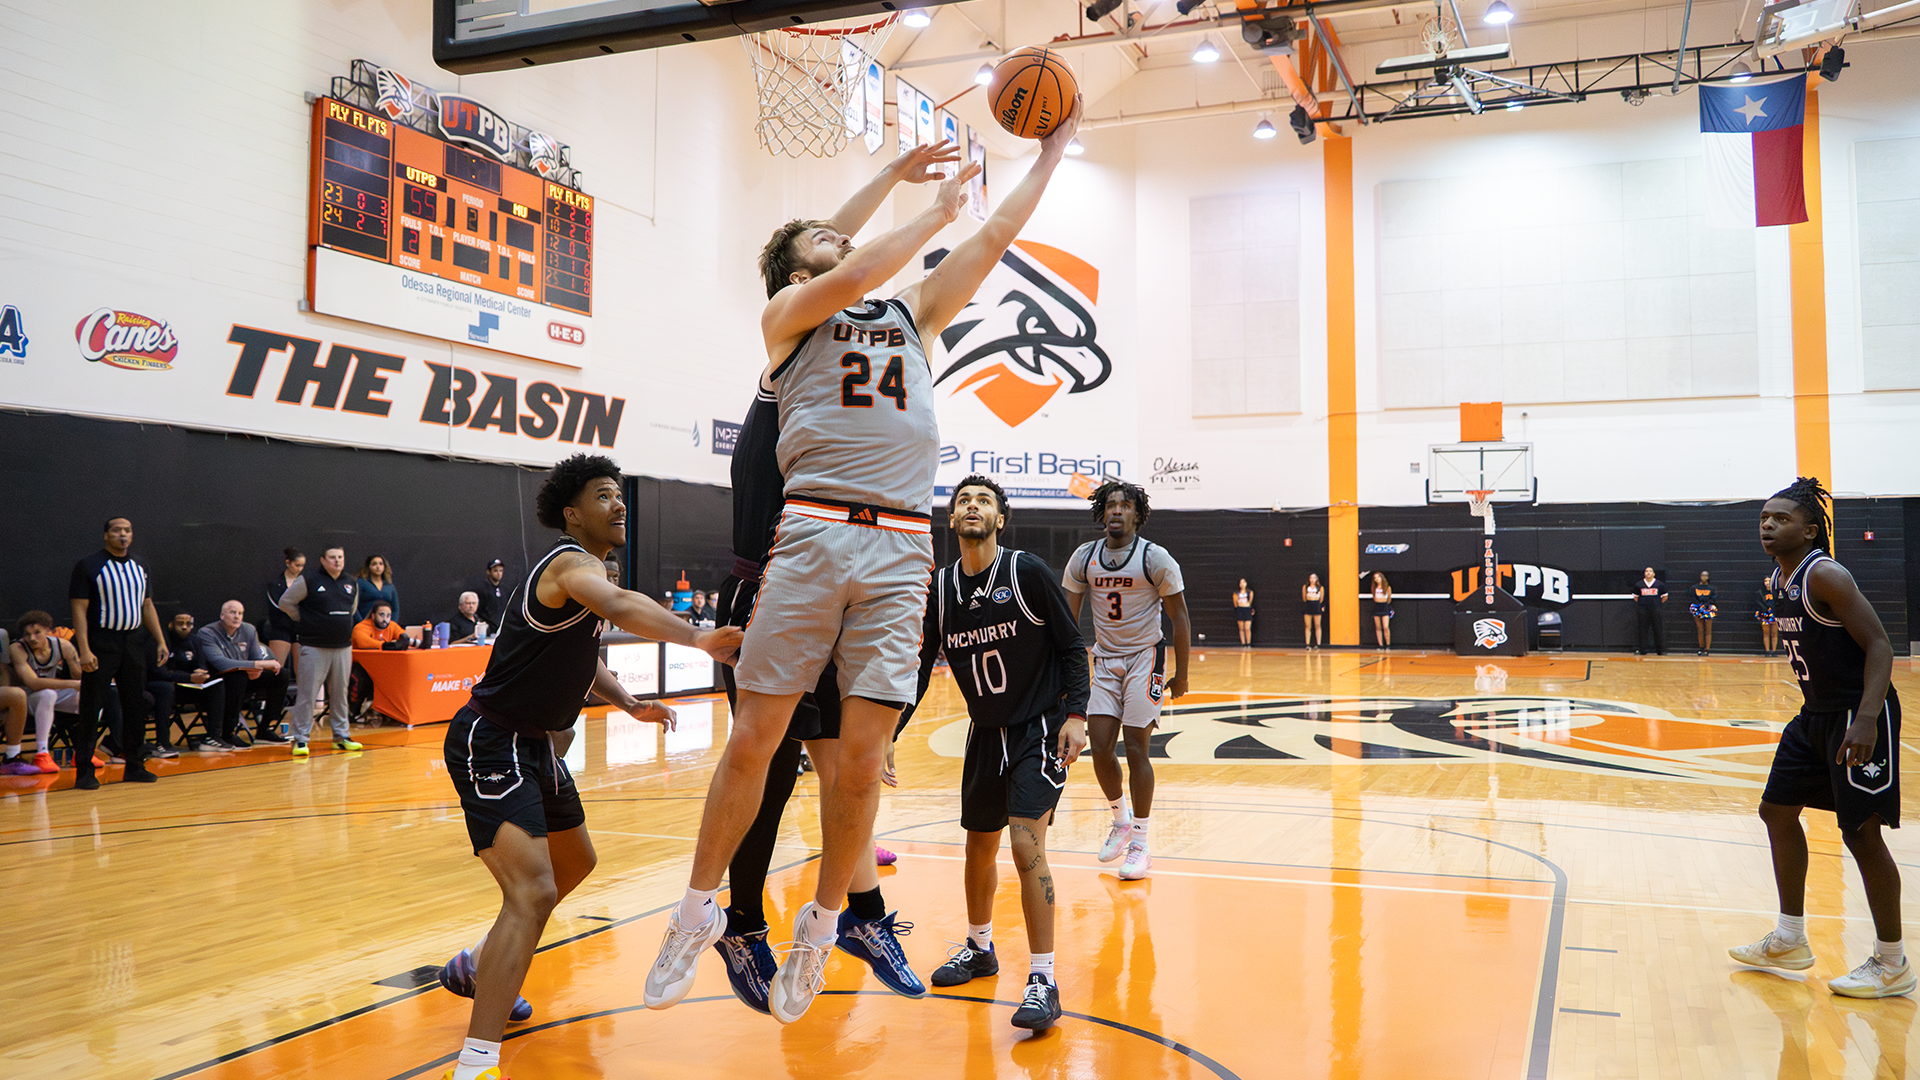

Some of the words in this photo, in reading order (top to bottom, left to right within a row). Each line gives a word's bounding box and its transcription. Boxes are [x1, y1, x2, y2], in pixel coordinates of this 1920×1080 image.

[330, 102, 350, 122] PLY
[353, 111, 366, 129] FL
[367, 116, 387, 136] PTS
[443, 100, 508, 151] UTPB
[406, 166, 437, 188] UTPB
[324, 182, 343, 203] 23
[357, 192, 366, 210] 0
[380, 200, 388, 217] 3
[411, 187, 436, 219] 55
[549, 184, 563, 201] PLY
[565, 190, 575, 205] FL
[575, 193, 590, 210] PTS
[324, 203, 342, 223] 24
[356, 213, 365, 231] 2
[512, 203, 528, 219] MU
[569, 206, 576, 221] 2
[400, 215, 422, 231] FOULS
[569, 224, 576, 239] 2
[409, 230, 418, 252] 2
[453, 231, 476, 247] PLAYER
[476, 238, 492, 252] FOUL
[399, 254, 421, 269] SCORE
[517, 251, 536, 265] FOULS
[401, 274, 434, 294] Odessa
[436, 283, 472, 303] Regional
[474, 293, 506, 313] Medical
[507, 301, 532, 319] Center
[516, 286, 535, 300] SCORE
[116, 313, 151, 330] Raising
[79, 307, 178, 362] Cane's
[832, 323, 906, 348] UTPB
[225, 323, 406, 418] THE
[419, 360, 626, 449] BASIN
[840, 351, 907, 411] 24
[971, 451, 1032, 474] First
[1039, 453, 1121, 476] Basin
[1153, 457, 1199, 475] Odessa
[1149, 474, 1200, 484] PUMPS
[1094, 577, 1133, 588] UTPB
[1484, 539, 1495, 605] FALCONS
[1106, 591, 1122, 621] 3
[947, 620, 1017, 649] MCMURRY
[669, 661, 709, 670] PROPETRO
[971, 649, 1007, 697] 10
[430, 680, 461, 693] MAKE
[629, 671, 654, 683] Basin
